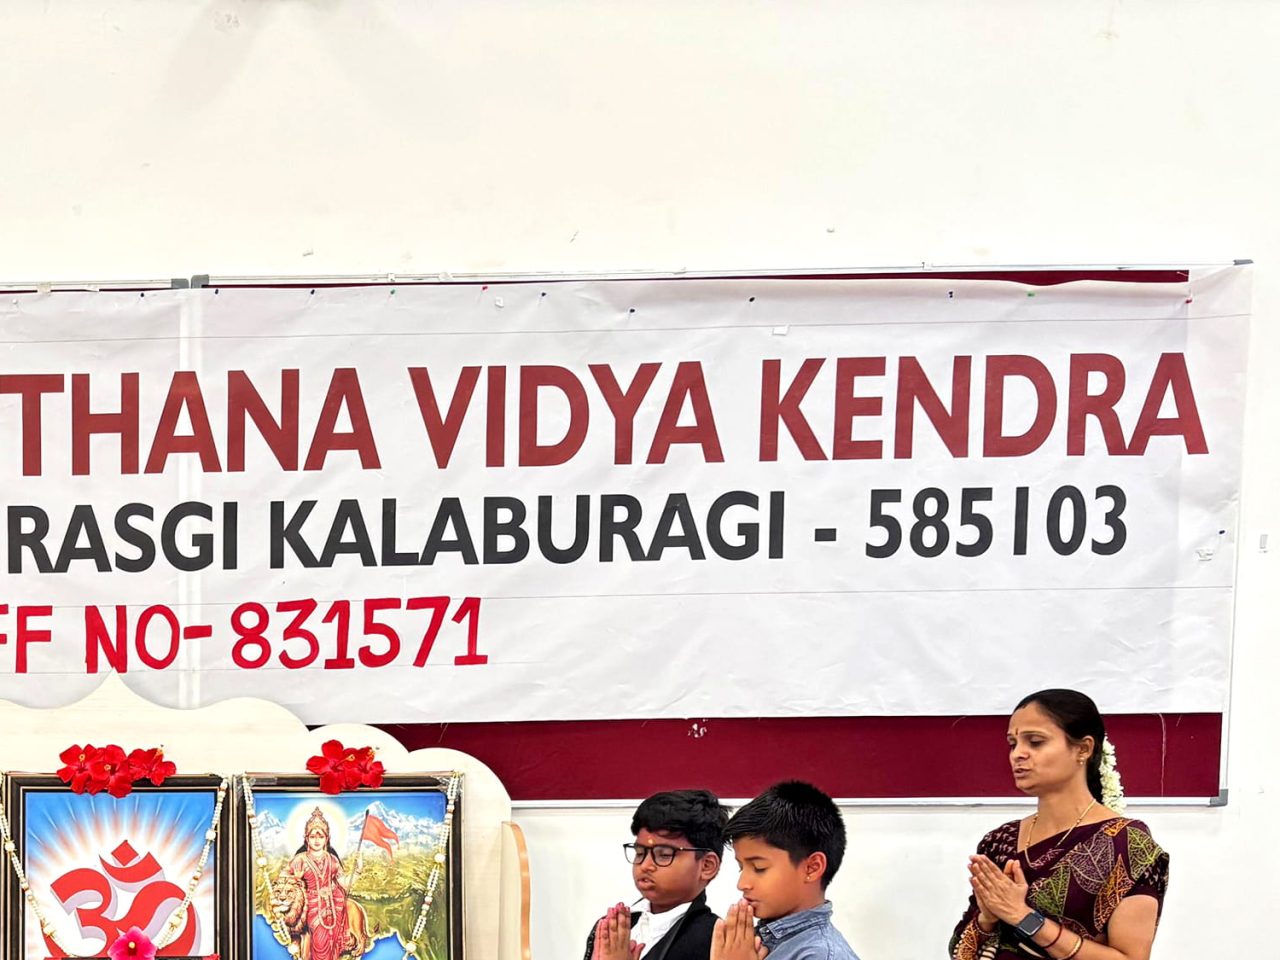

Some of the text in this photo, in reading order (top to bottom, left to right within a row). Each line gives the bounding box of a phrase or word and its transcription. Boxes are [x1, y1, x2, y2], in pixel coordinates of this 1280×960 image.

[408, 361, 724, 470] VIDYA
[759, 352, 1209, 461] KENDRA
[269, 490, 785, 570] KALABURAGI
[864, 484, 1128, 559] 585103
